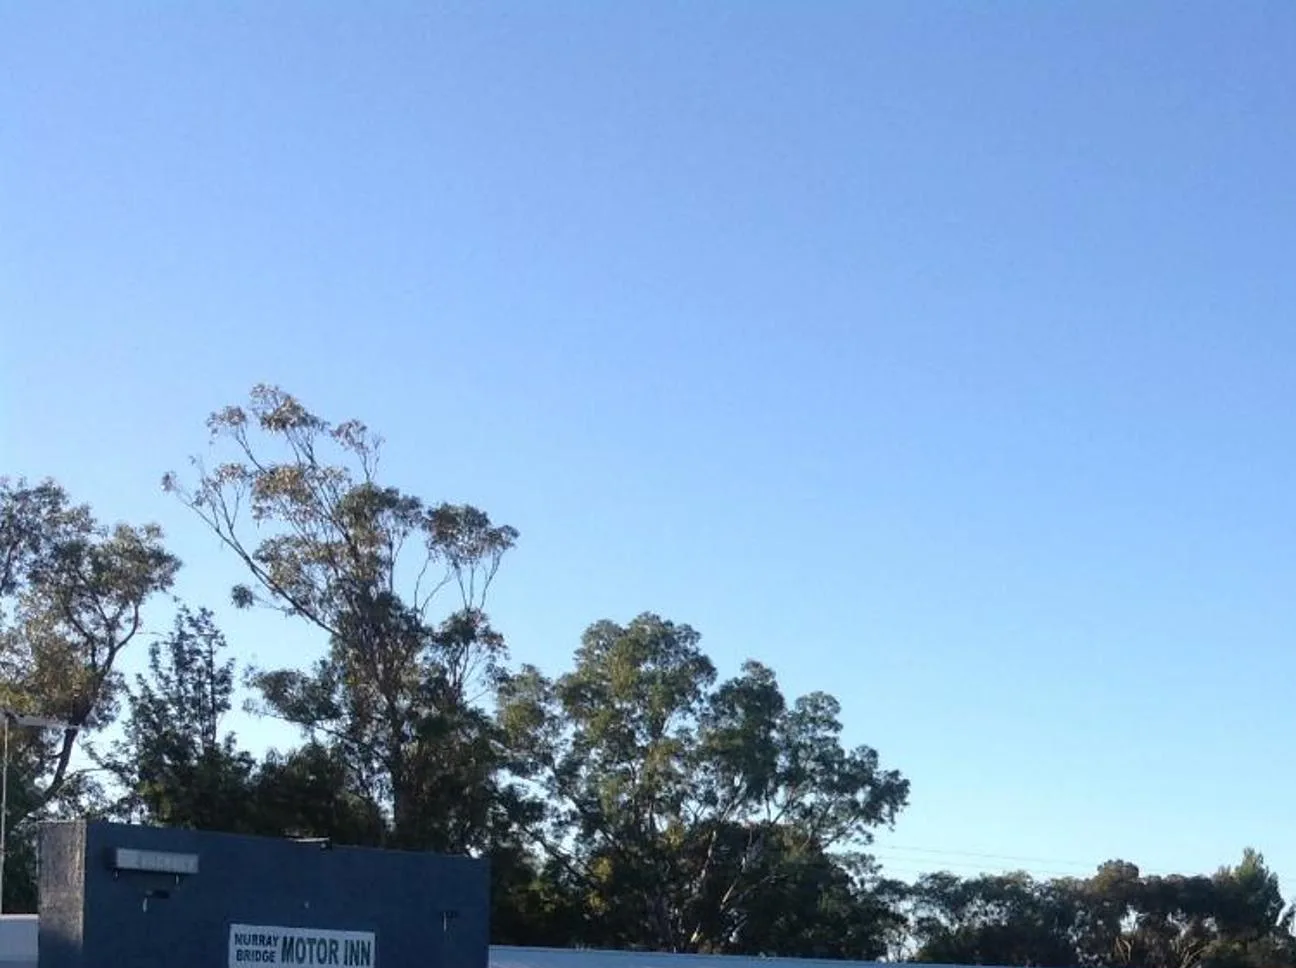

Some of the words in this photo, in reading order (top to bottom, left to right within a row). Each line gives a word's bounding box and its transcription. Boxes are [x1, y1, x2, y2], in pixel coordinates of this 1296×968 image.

[234, 933, 279, 947] MURRAY
[236, 949, 276, 963] BRIDGE
[281, 936, 339, 965] MOTOR
[344, 939, 371, 966] INN
